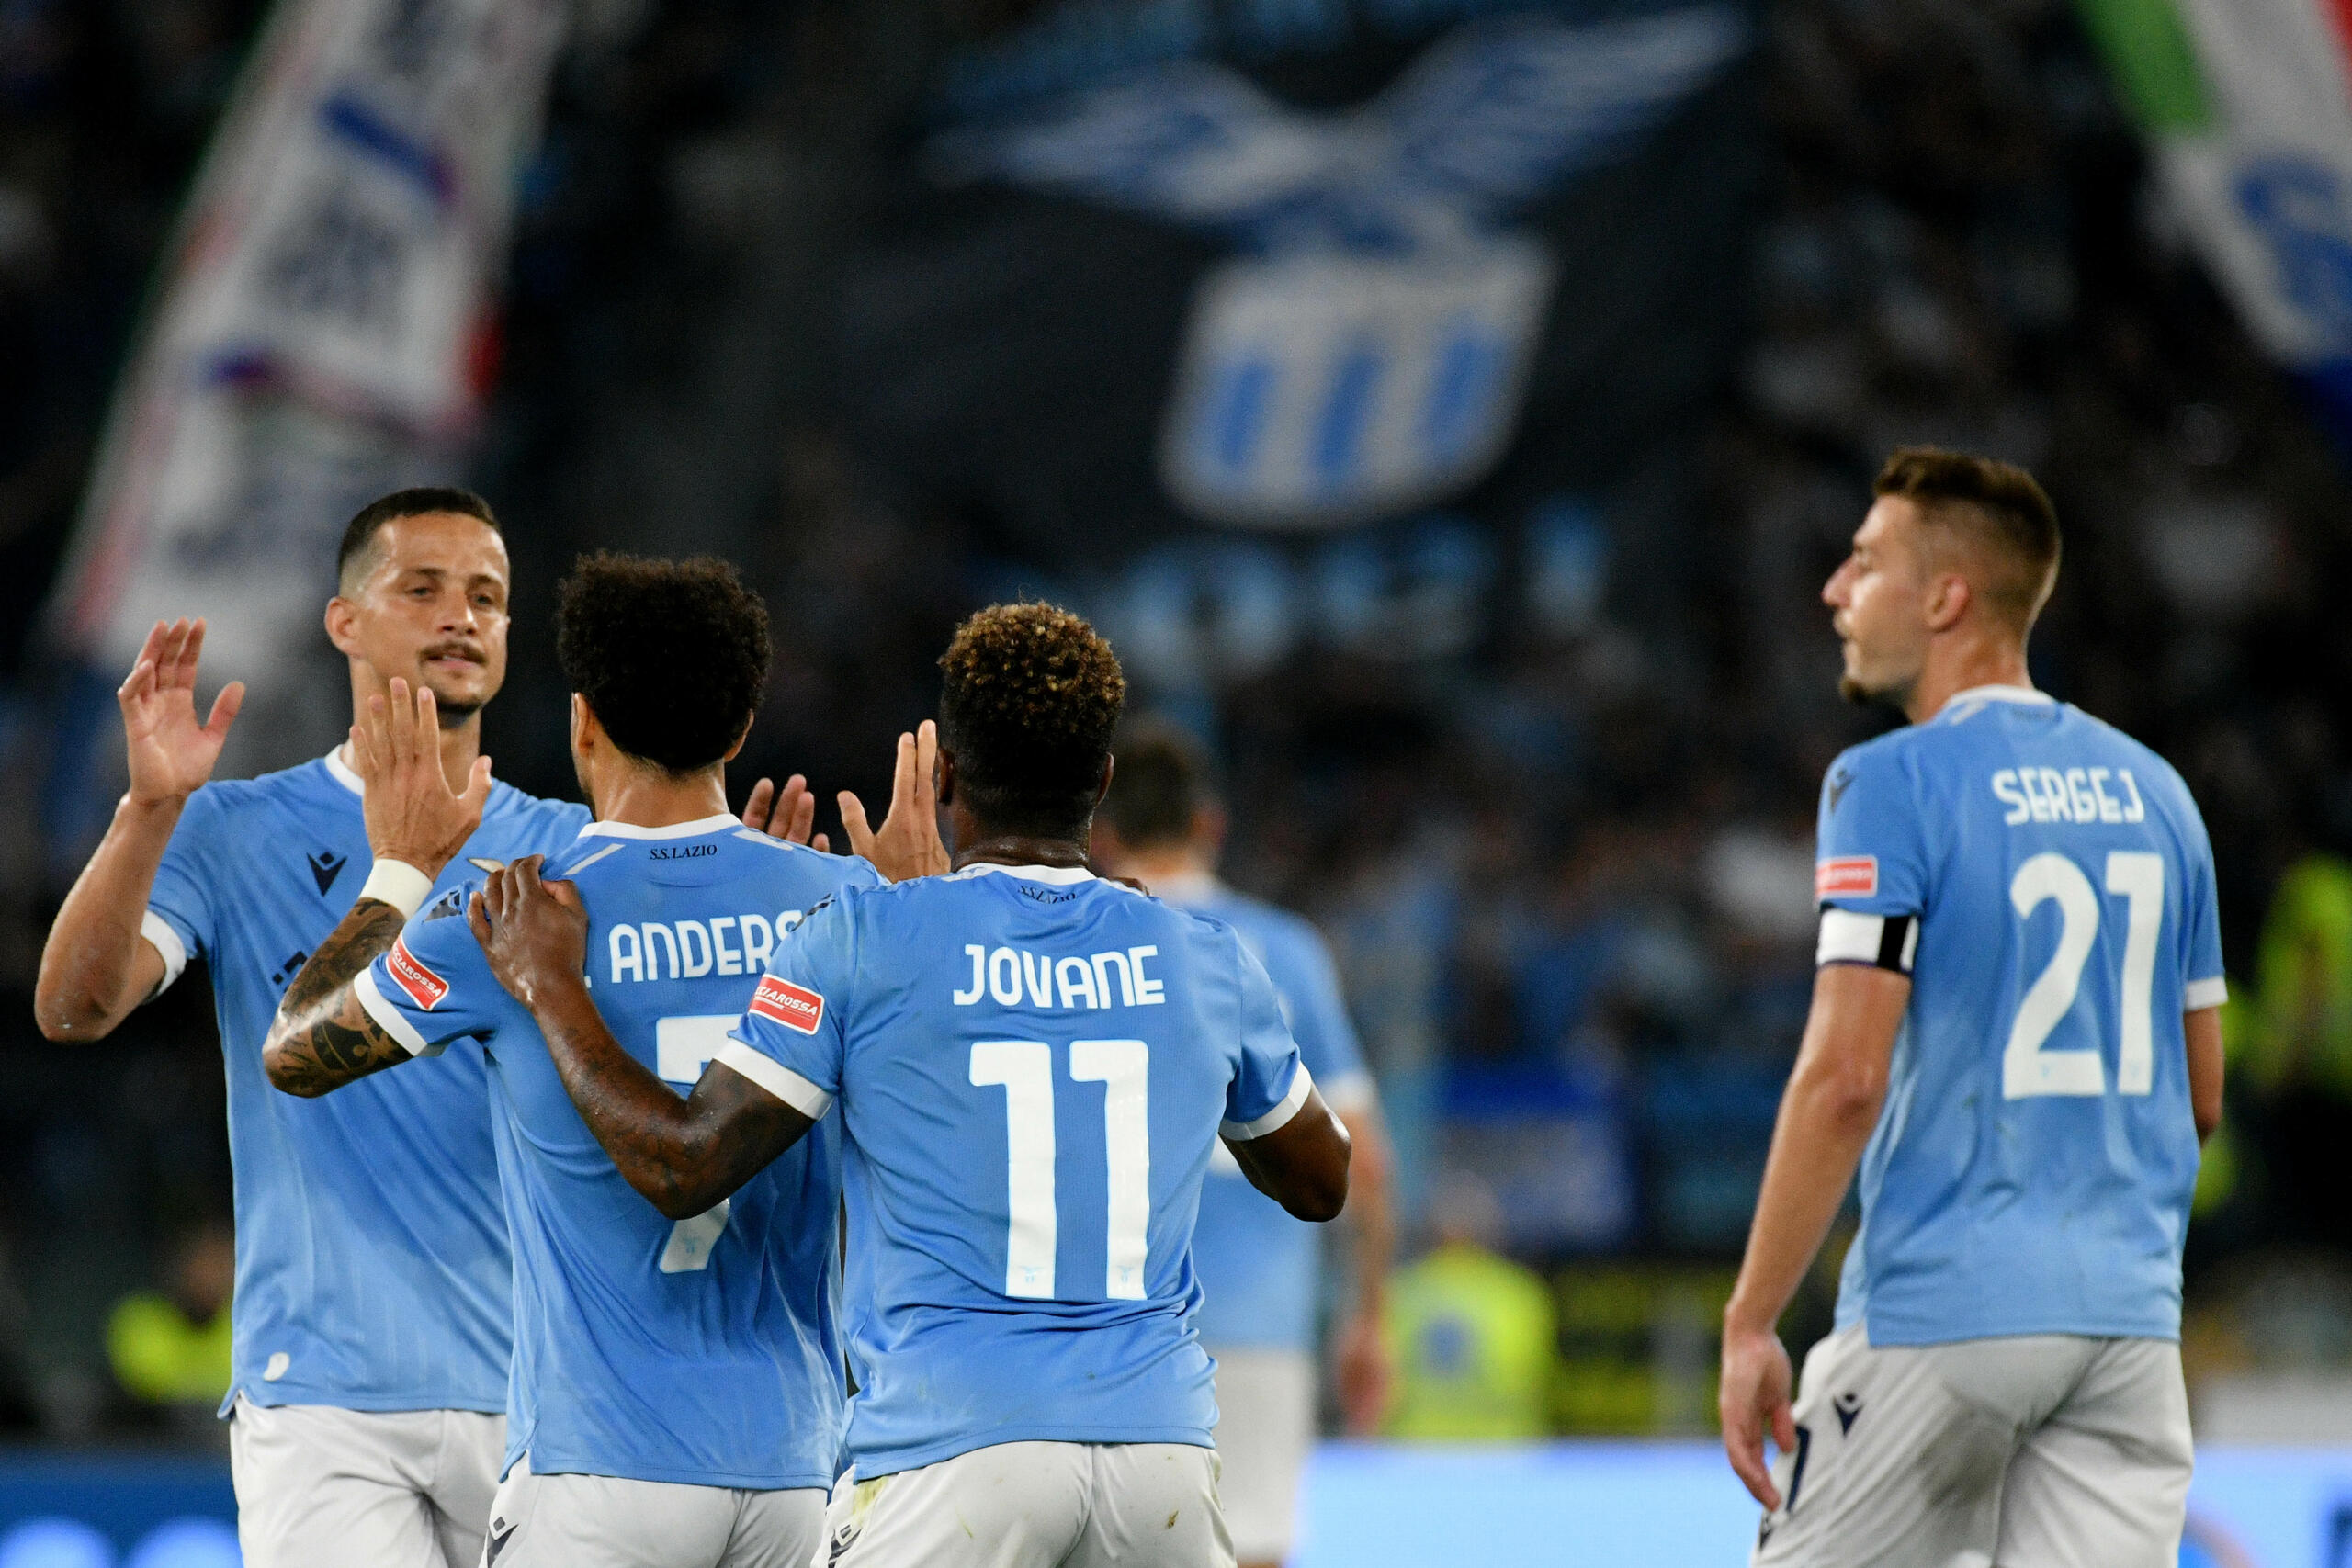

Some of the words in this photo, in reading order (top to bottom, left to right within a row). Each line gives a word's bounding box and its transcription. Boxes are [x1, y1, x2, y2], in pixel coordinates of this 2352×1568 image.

[1991, 766, 2144, 826] SERGEJ
[953, 943, 1166, 1010] JOVANE
[2003, 851, 2165, 1100] 21
[968, 1039, 1149, 1301] 11
